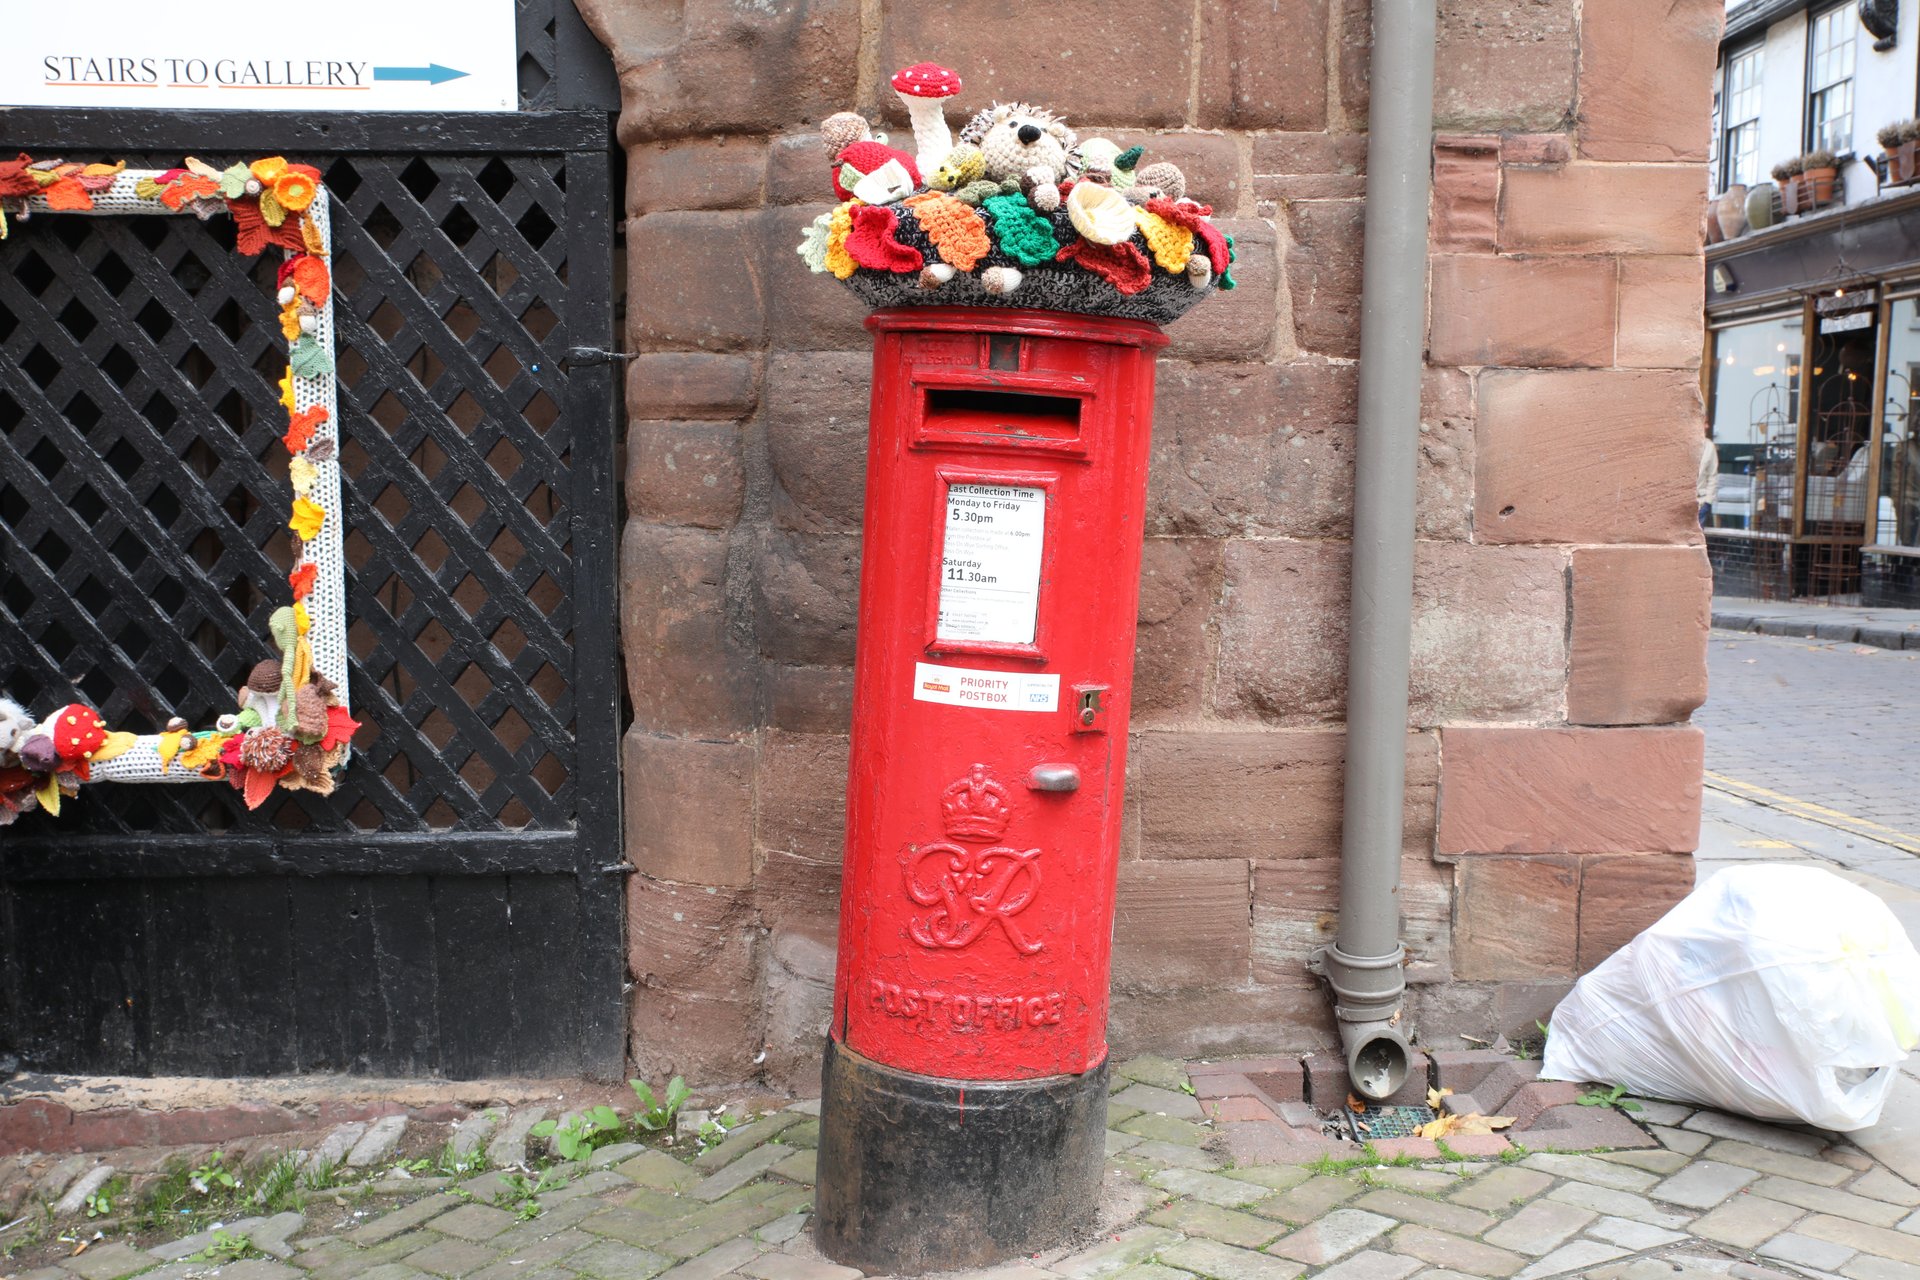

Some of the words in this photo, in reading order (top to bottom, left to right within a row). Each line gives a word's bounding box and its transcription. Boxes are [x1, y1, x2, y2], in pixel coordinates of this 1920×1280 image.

[43, 56, 158, 83] STAIRS
[165, 58, 209, 84] TO
[214, 59, 368, 85] GALLERY
[948, 485, 967, 493] Last
[969, 486, 1010, 496] Collection
[1013, 489, 1034, 499] Time
[947, 497, 981, 509] Monday
[993, 501, 1020, 512] Friday
[952, 508, 993, 524] 5.30pm
[942, 557, 982, 569] Saturday
[947, 567, 997, 583] 11.30am
[960, 676, 1008, 689] PRIORITY
[960, 690, 1008, 703] POSTBOX
[1030, 693, 1048, 703] NHS
[870, 978, 946, 1020] POST
[952, 991, 1065, 1030] OFFICE
